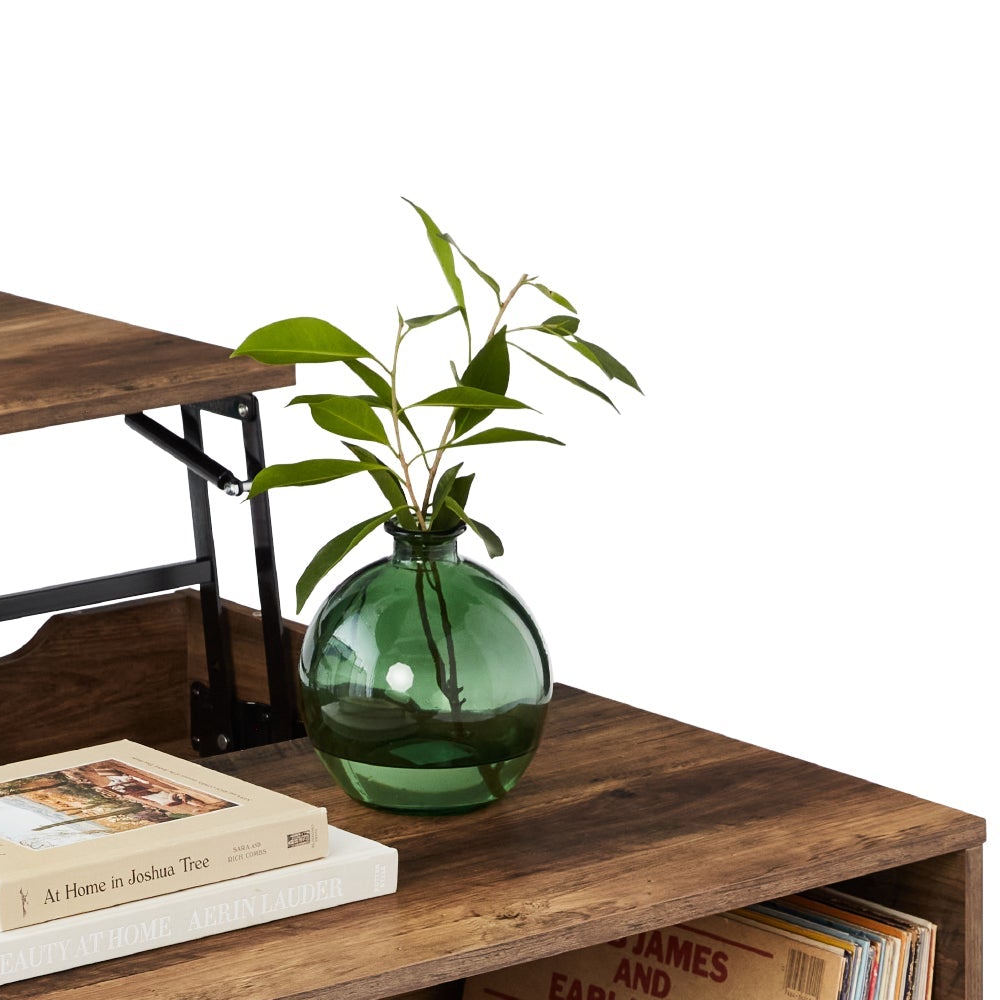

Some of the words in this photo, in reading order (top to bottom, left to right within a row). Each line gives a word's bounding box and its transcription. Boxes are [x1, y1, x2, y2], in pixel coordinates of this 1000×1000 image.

[44, 888, 61, 904] At
[65, 881, 107, 900] Home
[111, 876, 124, 890] in
[128, 865, 176, 886] Joshua
[178, 856, 211, 873] Tree
[70, 932, 106, 961] AT
[107, 916, 172, 951] HOME
[187, 897, 256, 932] AERIN
[260, 877, 344, 915] LAUDER
[613, 957, 671, 999] AND
[631, 930, 729, 984] JAMES
